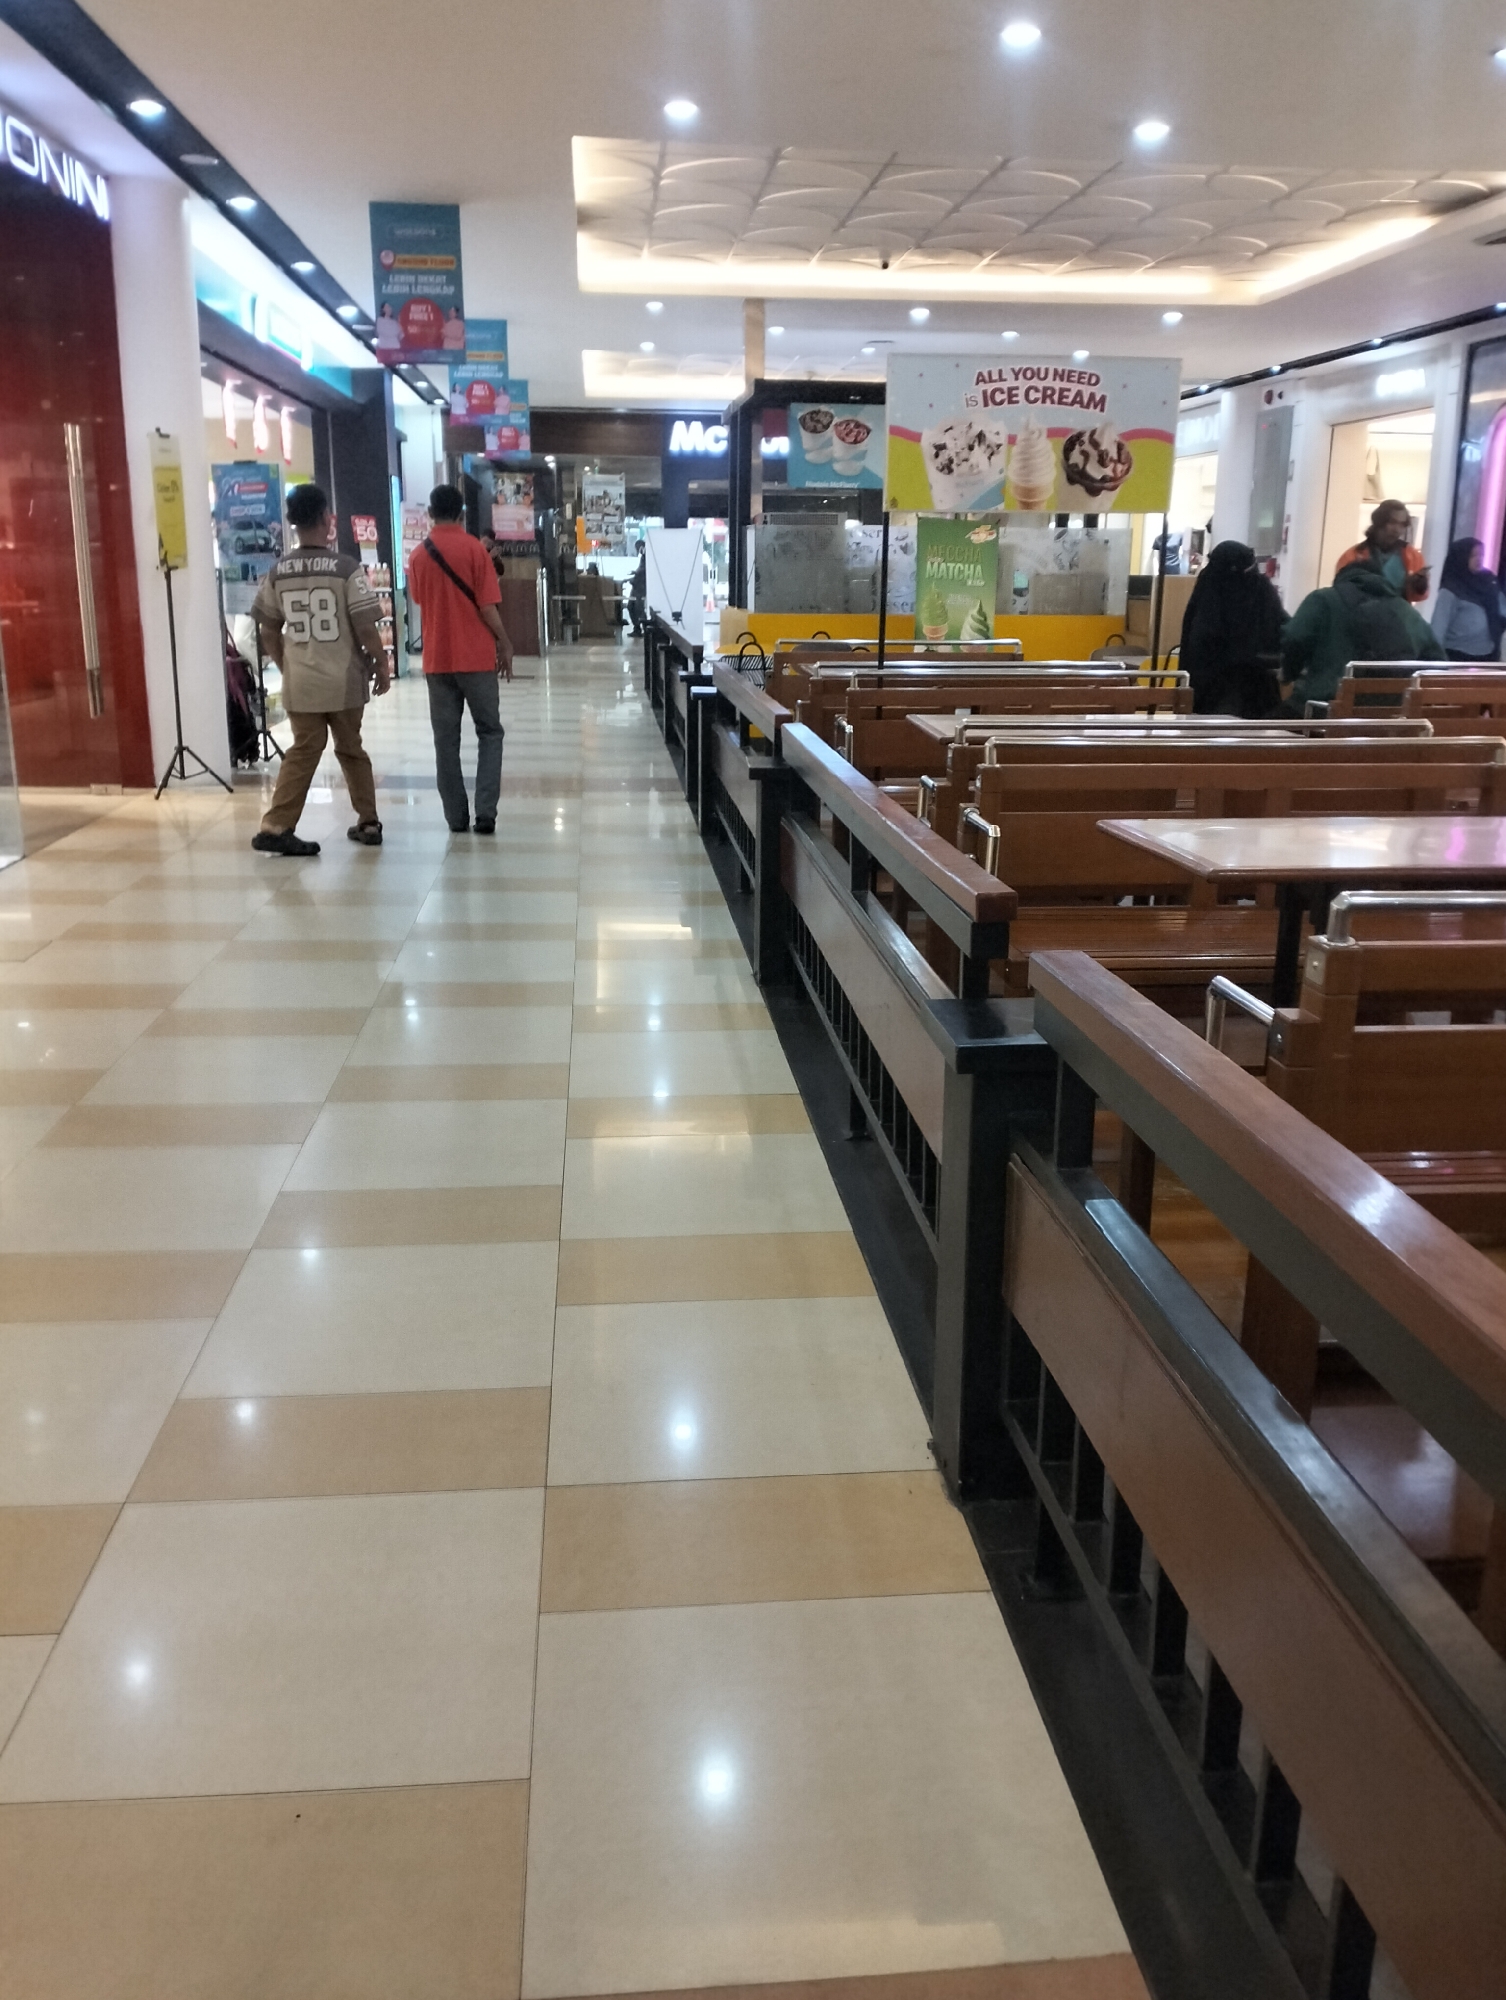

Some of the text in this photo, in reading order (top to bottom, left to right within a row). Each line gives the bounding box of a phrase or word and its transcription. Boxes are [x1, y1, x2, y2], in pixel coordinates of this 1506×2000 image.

[0, 113, 110, 221] ONINI
[975, 366, 1101, 387] ALL YOU NEED
[964, 385, 1108, 414] is ICE CREAM
[356, 526, 378, 541] 50
[927, 543, 983, 563] MECCHA
[276, 557, 339, 574] NEW YORK
[925, 561, 985, 584] MATCHA
[281, 587, 340, 643] 58
